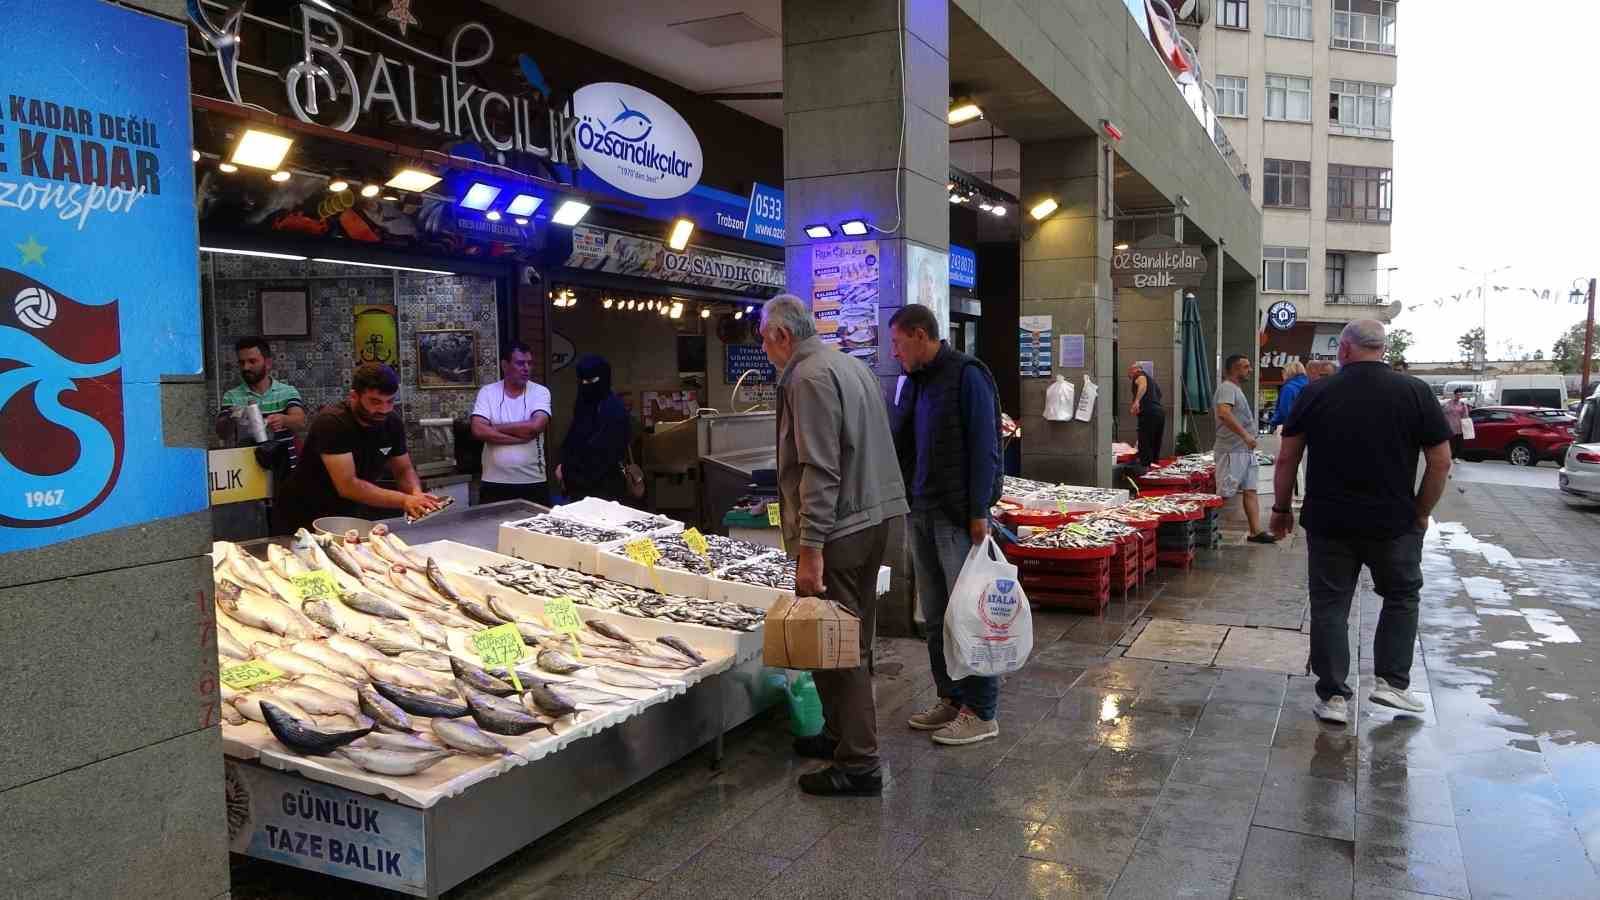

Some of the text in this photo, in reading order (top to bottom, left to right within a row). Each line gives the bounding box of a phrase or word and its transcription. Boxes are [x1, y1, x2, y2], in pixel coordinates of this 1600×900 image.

[9, 94, 93, 136] KADAR
[99, 112, 160, 149] DEĞİL
[19, 128, 160, 195] KADAR
[0, 181, 146, 231] zonspor
[716, 212, 744, 231] Trabzon
[756, 193, 781, 221] 0533
[1134, 271, 1176, 288] Balık
[25, 489, 65, 508] 1967
[281, 788, 381, 834] GÜNLÜK
[265, 824, 402, 877] TAZE BALIK
